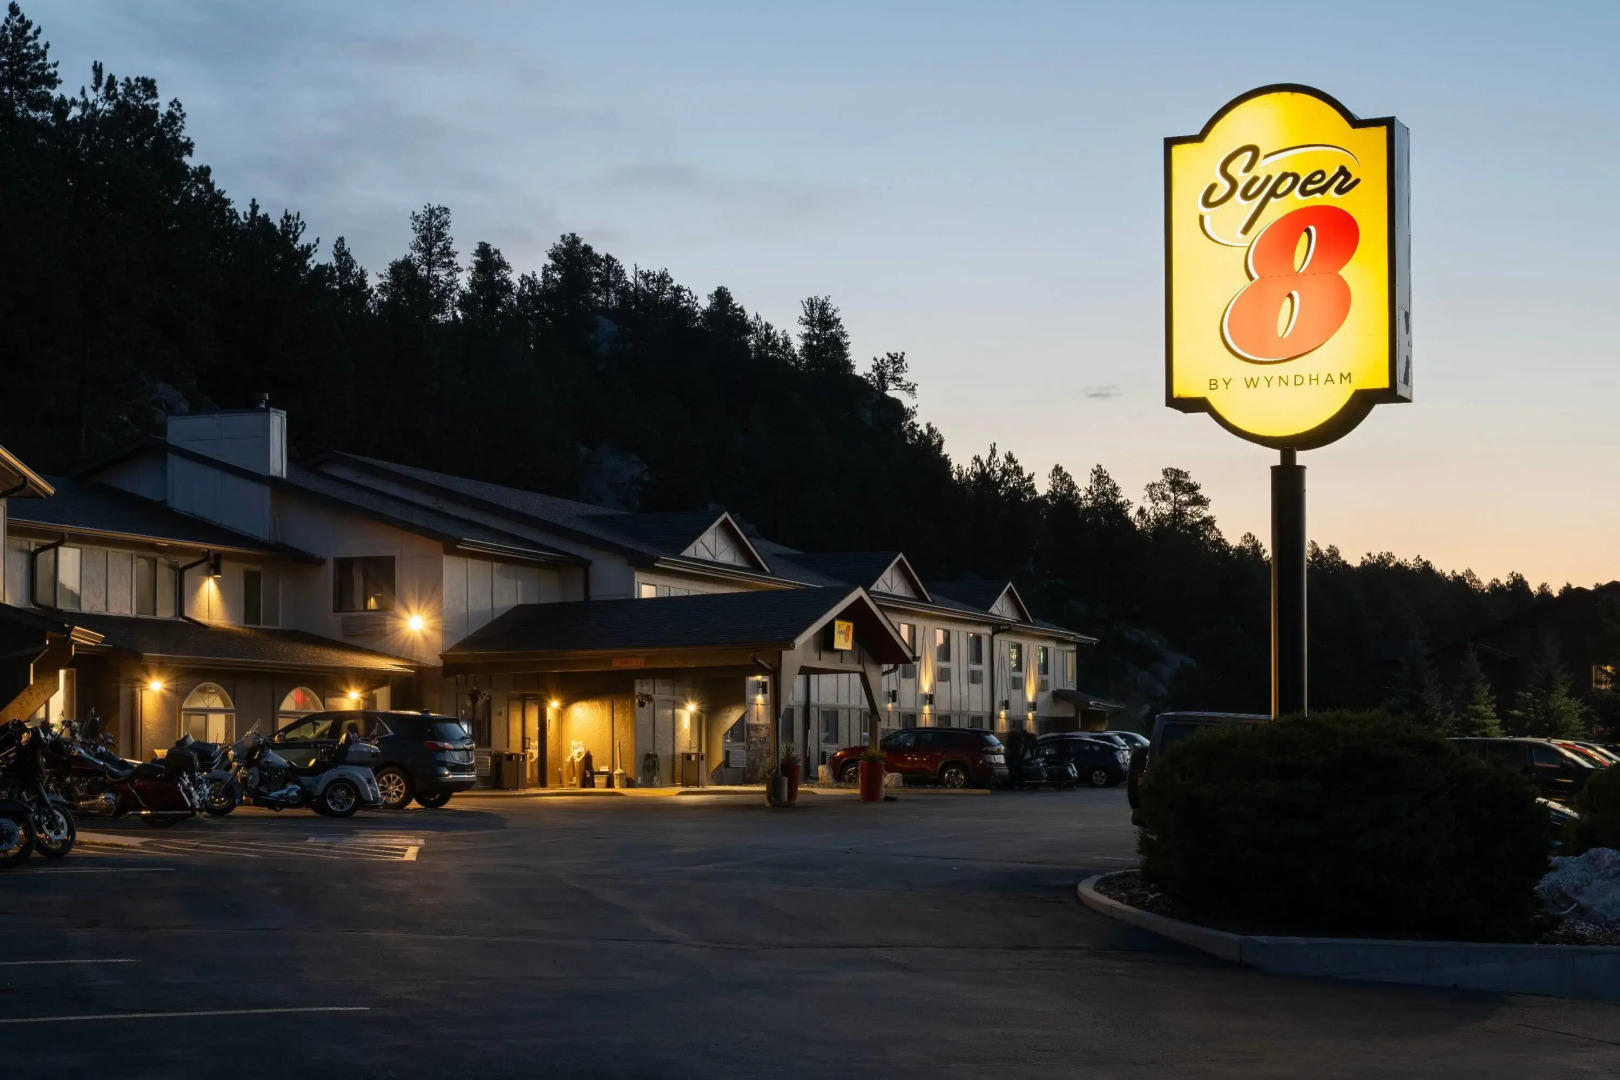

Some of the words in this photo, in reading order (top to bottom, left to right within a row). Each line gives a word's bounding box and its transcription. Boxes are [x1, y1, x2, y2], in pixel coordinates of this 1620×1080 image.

[1199, 144, 1361, 238] Super
[1219, 205, 1360, 364] 8
[1209, 378, 1232, 390] BY
[1244, 372, 1352, 389] WYNDHAM
